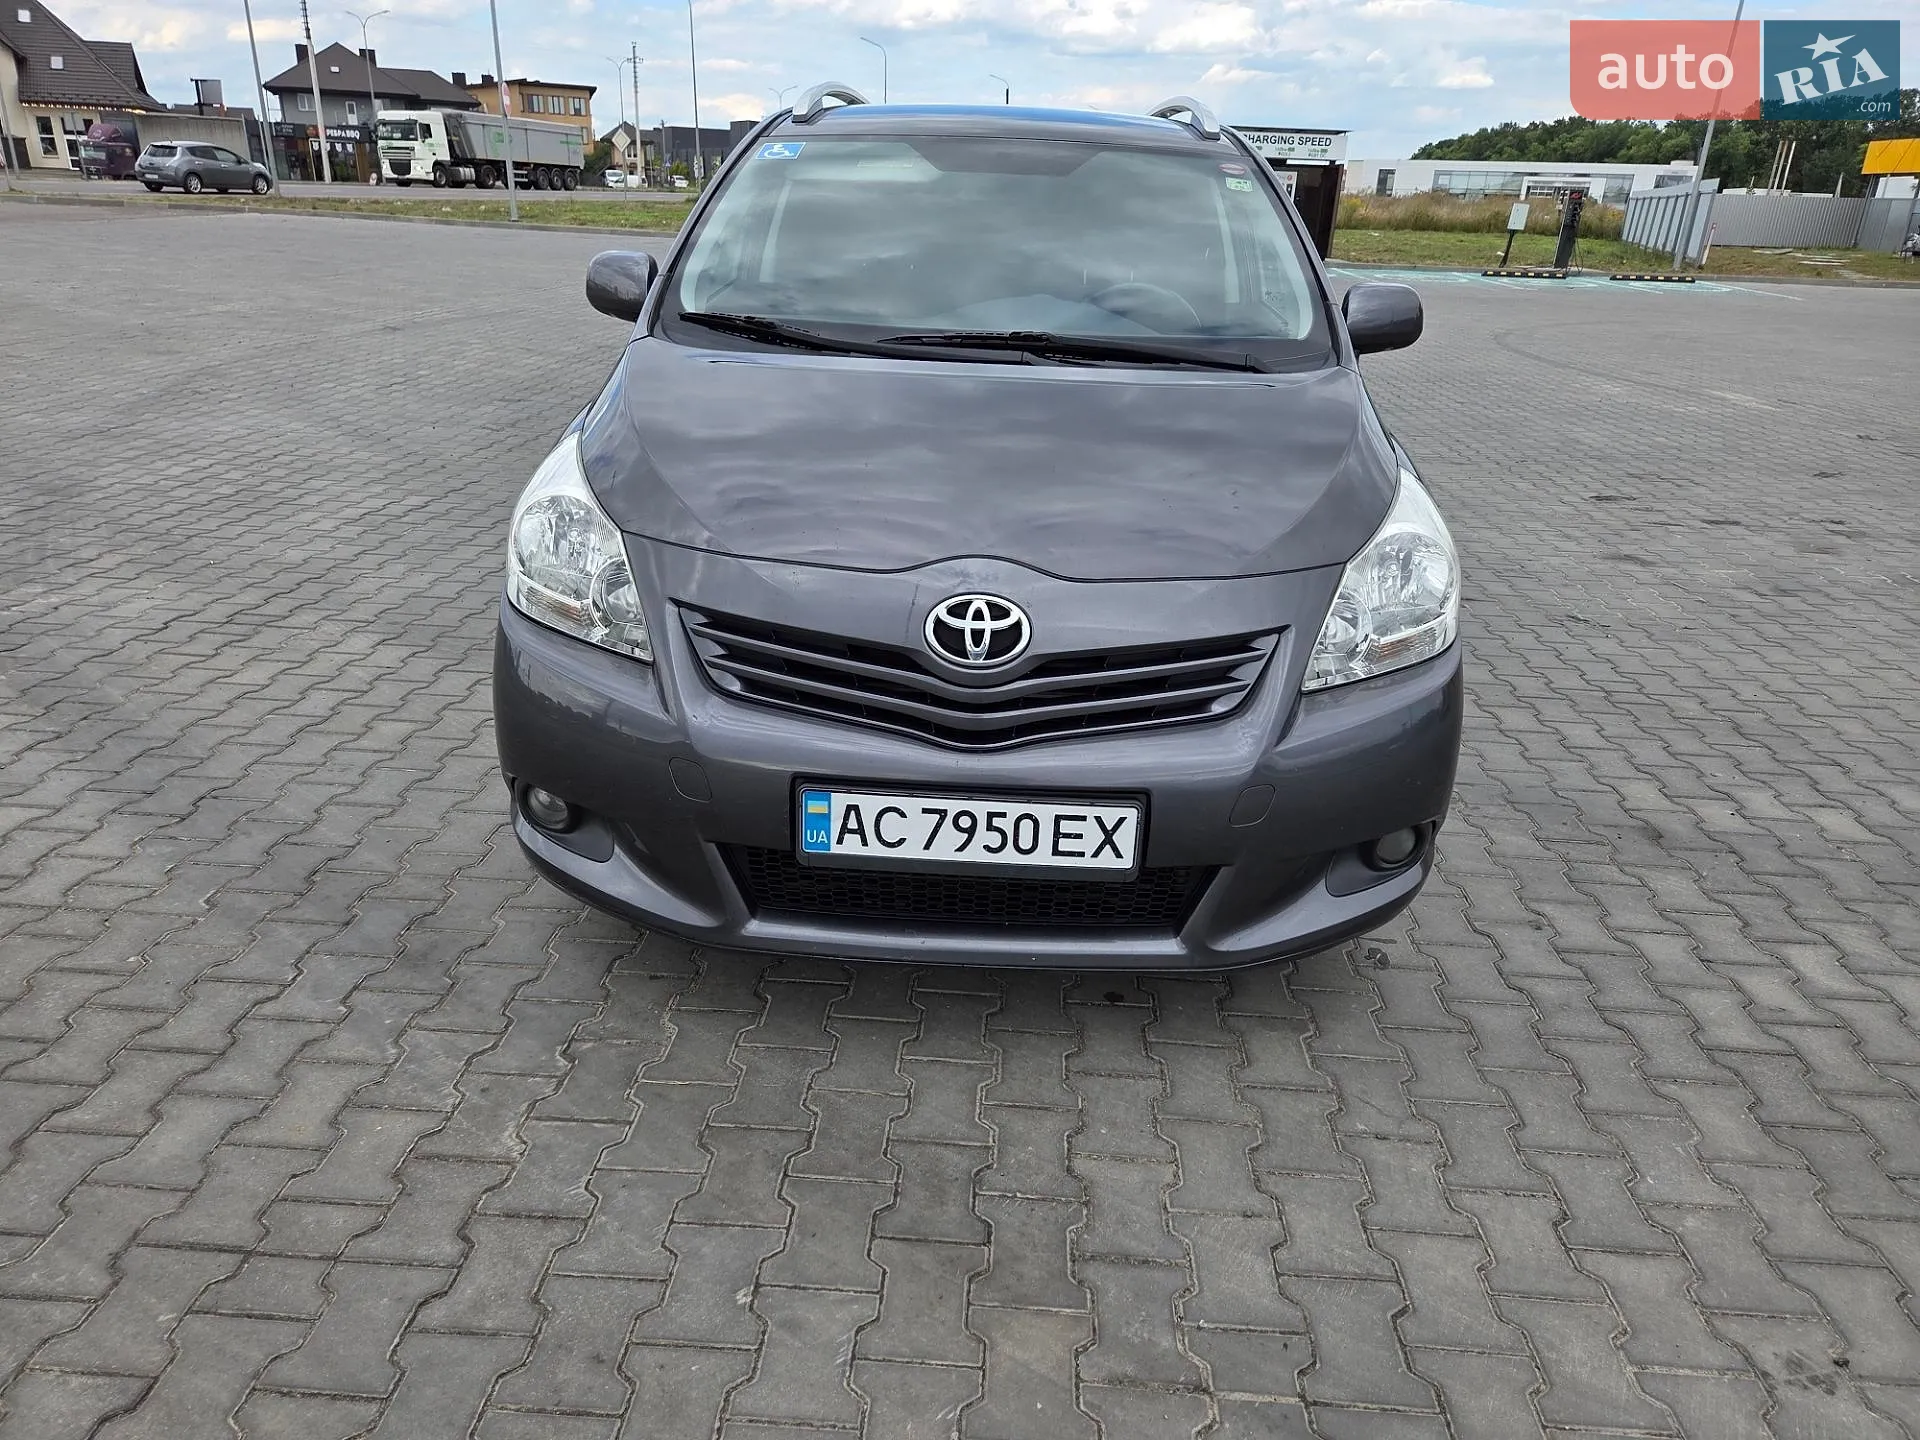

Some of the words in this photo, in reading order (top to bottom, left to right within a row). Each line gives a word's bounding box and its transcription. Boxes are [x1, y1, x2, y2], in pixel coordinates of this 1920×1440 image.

[1297, 136, 1332, 147] SPEED
[806, 829, 829, 844] UA
[835, 803, 908, 849] AC
[921, 807, 1040, 855] 7950
[1051, 814, 1128, 859] EX
